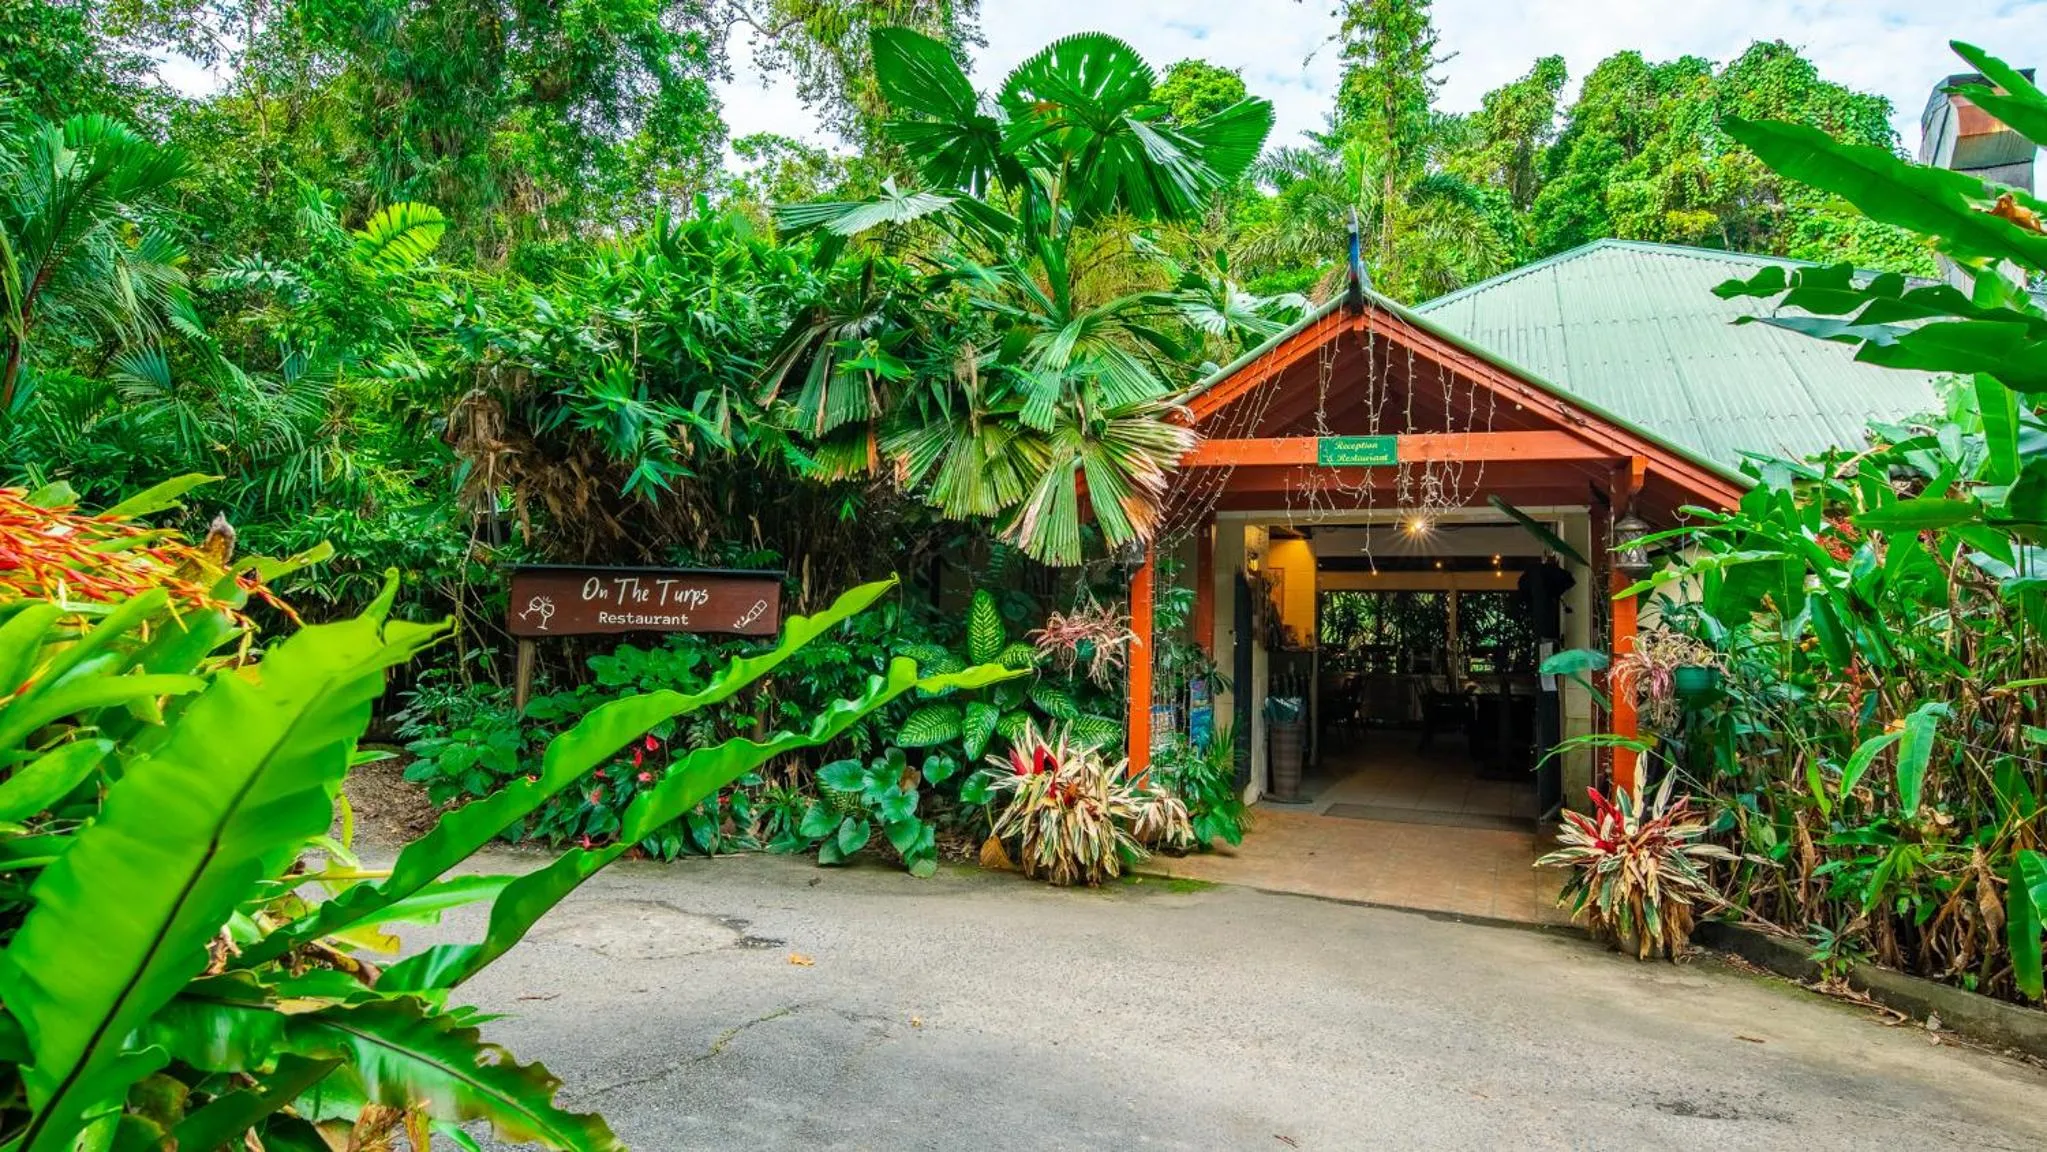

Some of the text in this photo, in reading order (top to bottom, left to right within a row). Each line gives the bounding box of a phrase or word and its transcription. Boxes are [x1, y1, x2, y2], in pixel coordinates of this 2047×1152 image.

[1335, 441, 1378, 452] Reception
[1336, 453, 1388, 462] Restaurant
[582, 576, 709, 610] On The Turps
[599, 611, 689, 626] Restaurant
